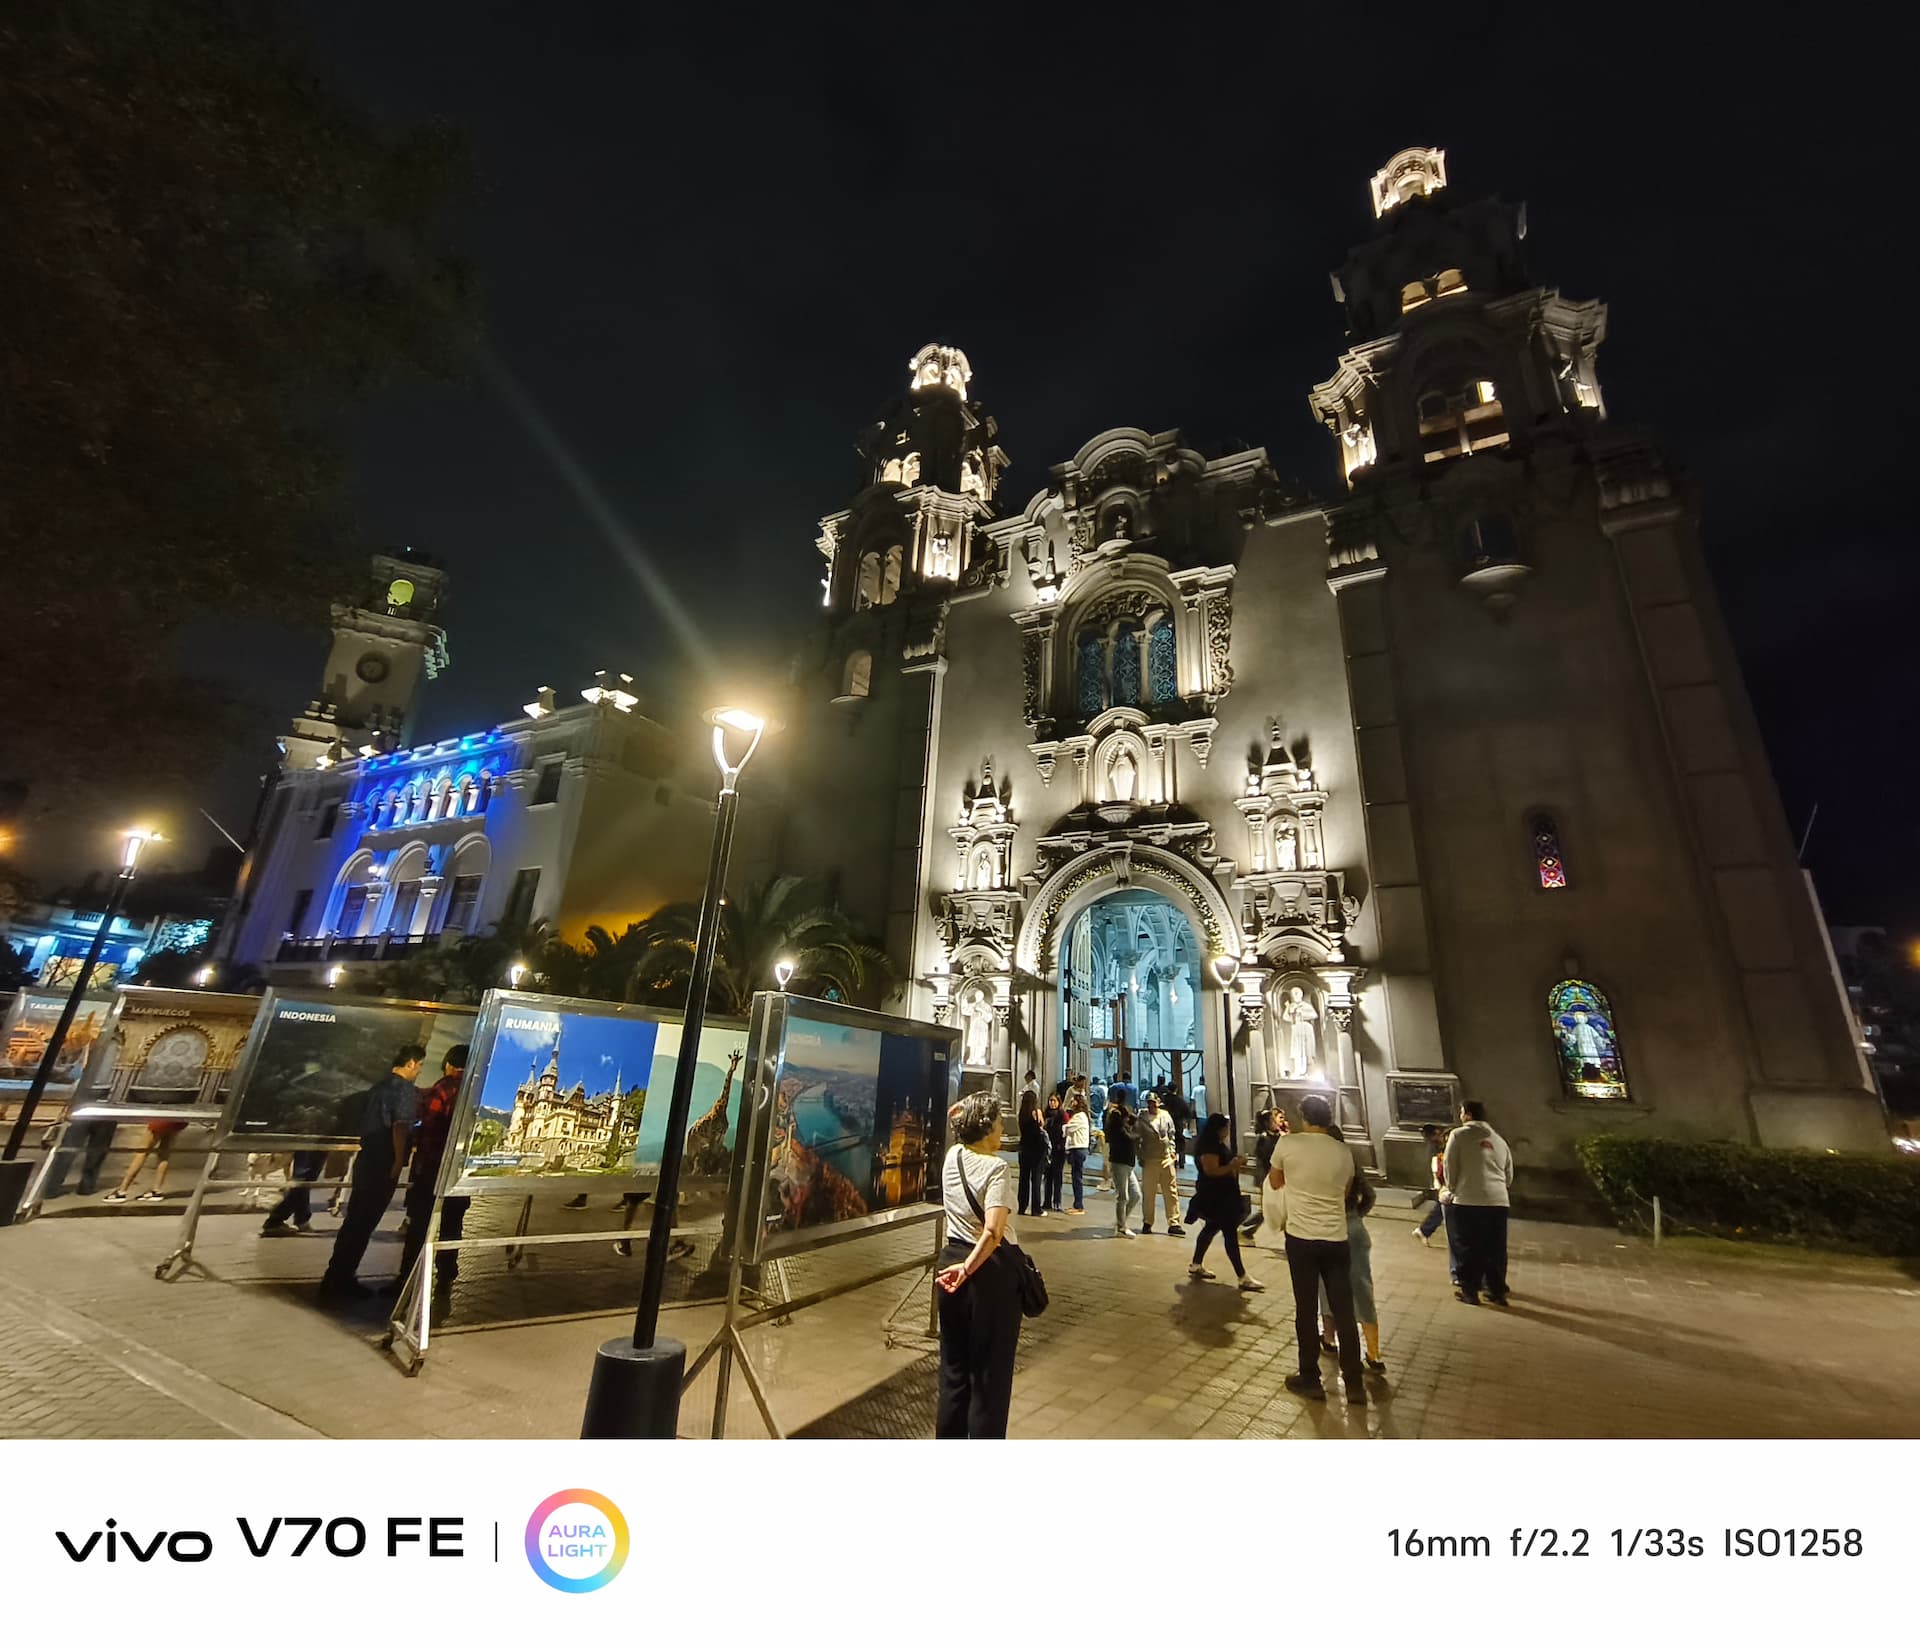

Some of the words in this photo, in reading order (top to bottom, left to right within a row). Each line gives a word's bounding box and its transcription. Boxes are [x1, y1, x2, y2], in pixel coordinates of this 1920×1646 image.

[131, 1007, 191, 1017] MARRUECOS
[279, 1010, 337, 1023] INDONESIA
[505, 1018, 560, 1033] RUMANIA
